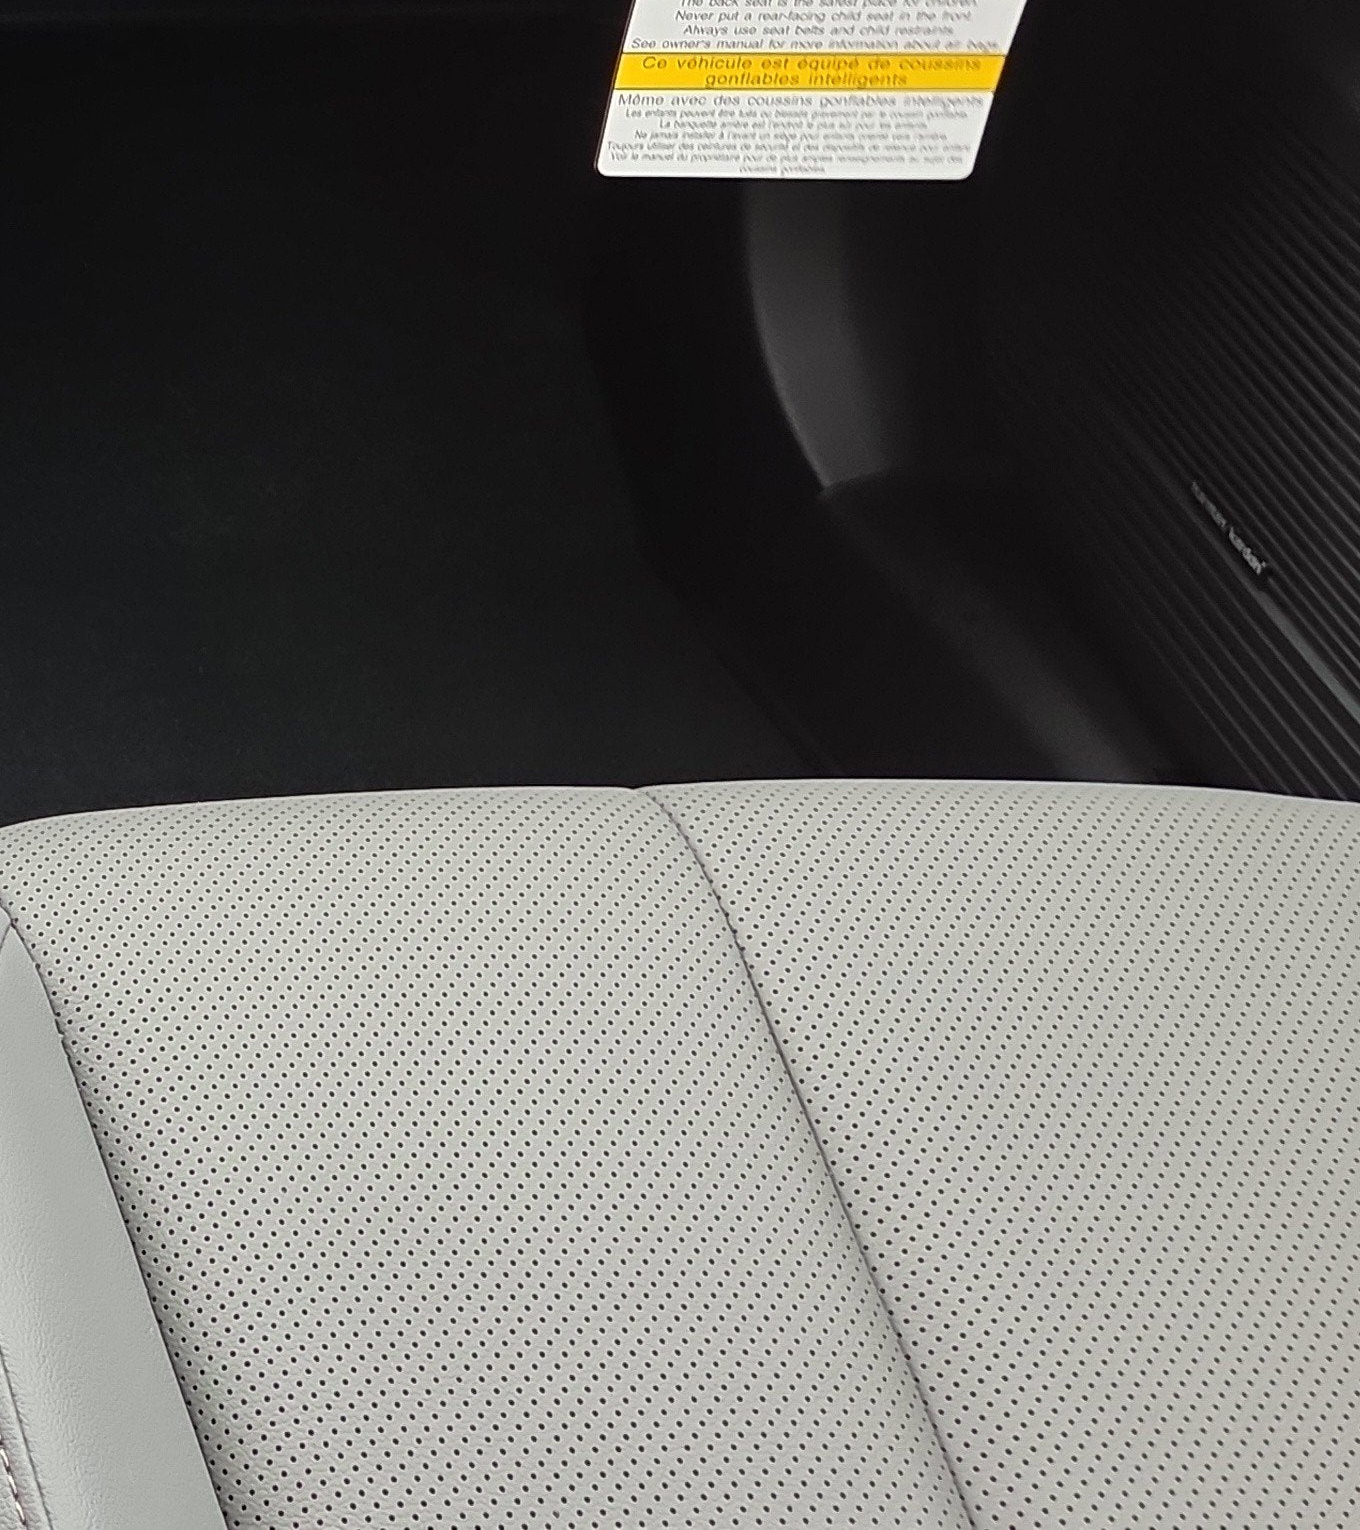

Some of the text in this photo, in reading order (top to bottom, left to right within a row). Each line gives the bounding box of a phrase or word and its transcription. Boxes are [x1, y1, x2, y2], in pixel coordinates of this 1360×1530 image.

[675, 10, 714, 21] Never
[718, 11, 740, 23] put
[744, 13, 752, 21] a
[683, 25, 728, 37] Always
[733, 27, 757, 36] use
[762, 25, 790, 36] seat
[830, 25, 856, 36] and
[631, 38, 656, 49] See
[662, 39, 711, 49] owner's
[716, 38, 764, 49] manual
[768, 38, 786, 49] for
[642, 56, 667, 70] Ce
[677, 56, 752, 70] véhicule
[761, 56, 790, 70] est
[867, 57, 891, 70] de
[705, 72, 908, 89] gonflables intelligents
[671, 95, 706, 105] avec
[714, 94, 739, 105] des
